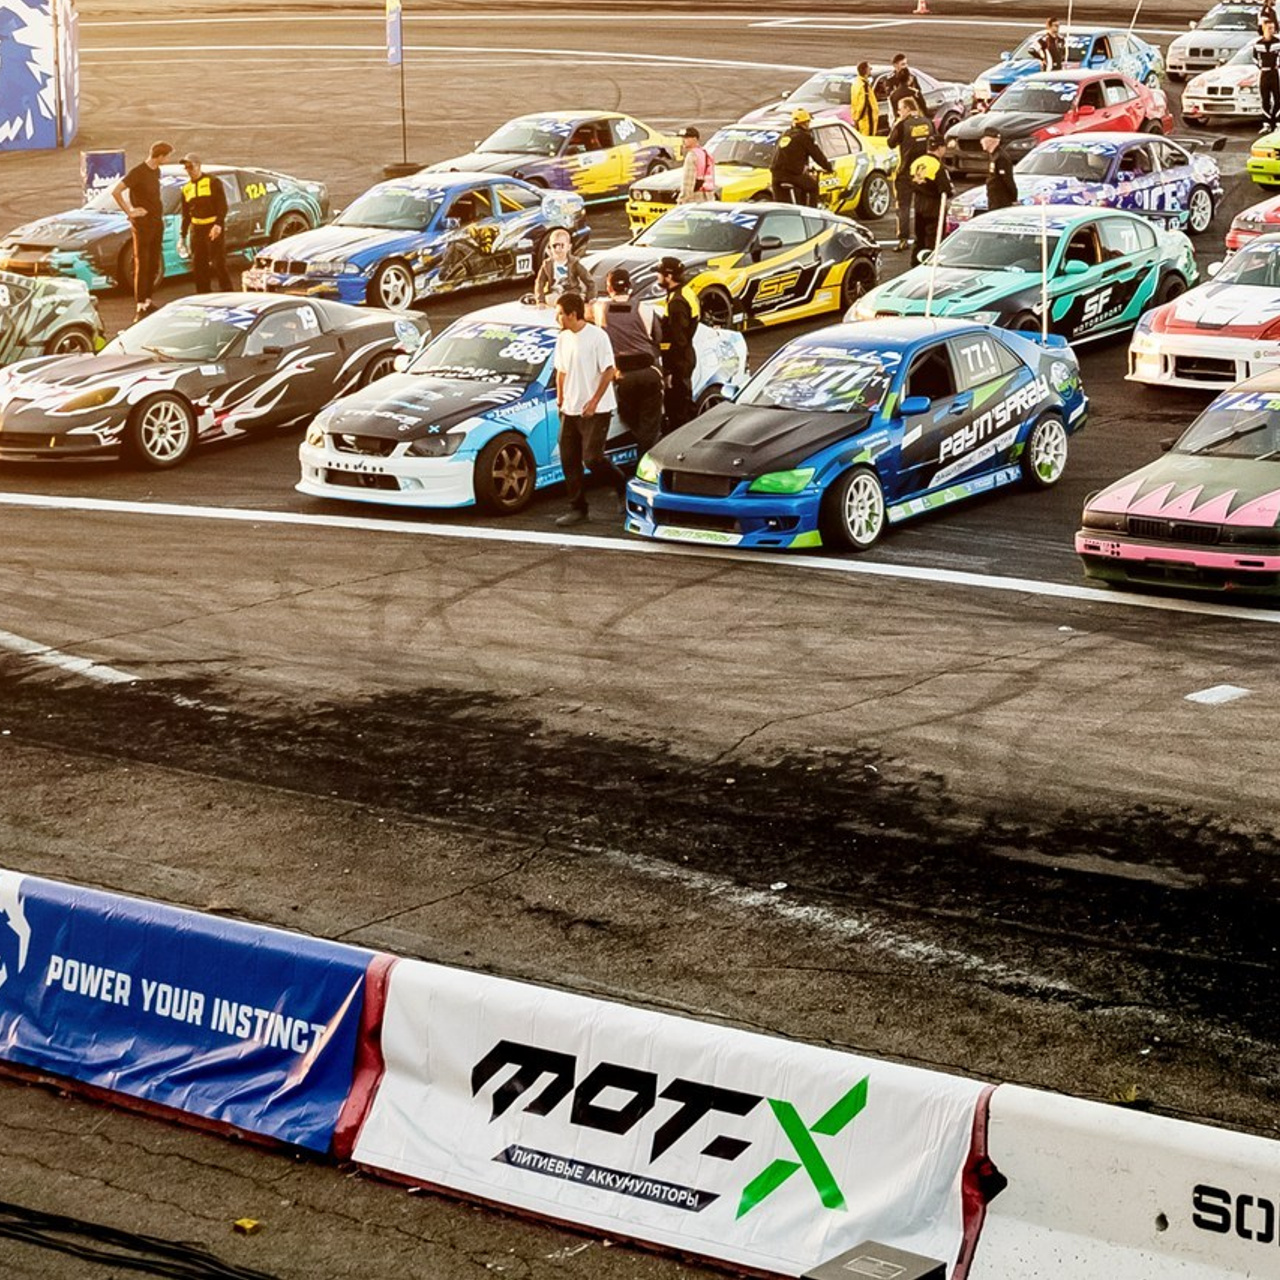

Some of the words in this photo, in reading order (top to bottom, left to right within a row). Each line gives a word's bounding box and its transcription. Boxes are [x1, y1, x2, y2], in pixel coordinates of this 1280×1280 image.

[245, 182, 266, 200] 124
[1073, 304, 1123, 335] MOTORSPORT
[1081, 288, 1113, 321] SF
[499, 342, 552, 364] 888
[961, 340, 994, 371] 771
[46, 955, 131, 1007] POWER
[141, 978, 205, 1026] YOUR
[211, 997, 328, 1054] INSTINCT
[510, 1147, 583, 1179] ЛИТИЕВЫЕ
[586, 1166, 700, 1208] АККУМУЛЯТОРЫ
